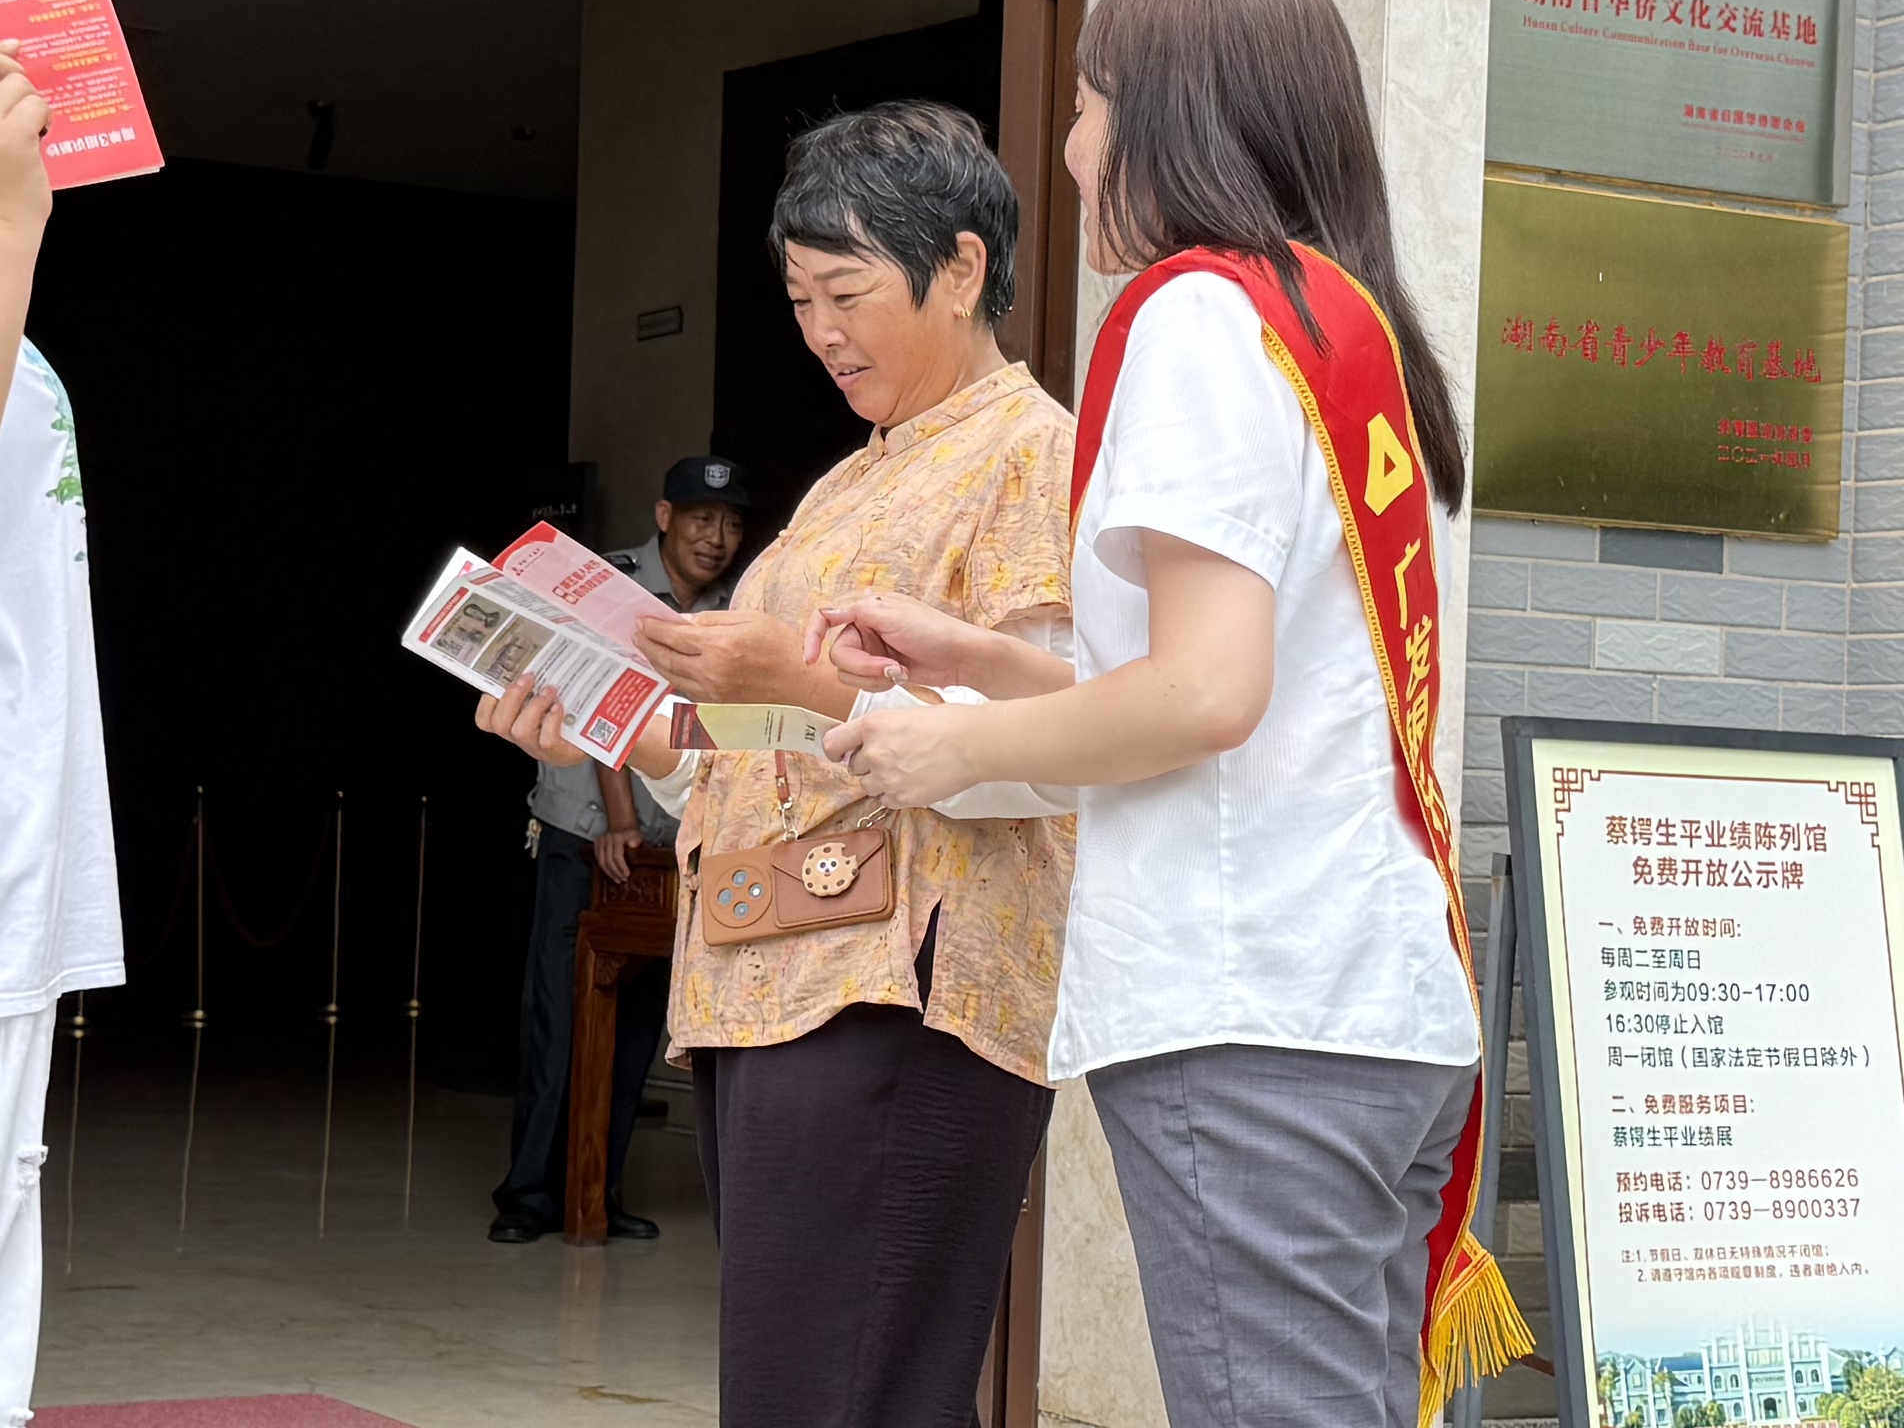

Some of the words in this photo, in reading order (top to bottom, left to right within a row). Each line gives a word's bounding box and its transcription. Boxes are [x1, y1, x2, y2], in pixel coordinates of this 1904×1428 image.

[1560, 22, 1601, 38] Culture
[1602, 28, 1686, 51] Communication
[1501, 314, 1822, 384] 湖南省青少年教育基地
[1605, 815, 1828, 854] 蔡锷生平业绩陈列馆
[1631, 856, 1805, 890] 免费开放公示牌
[1600, 947, 1701, 971] 每周二至周日
[1605, 1013, 1724, 1037] 16:30停止入馆
[1612, 1125, 1734, 1149] 蔡锷生平业绩展
